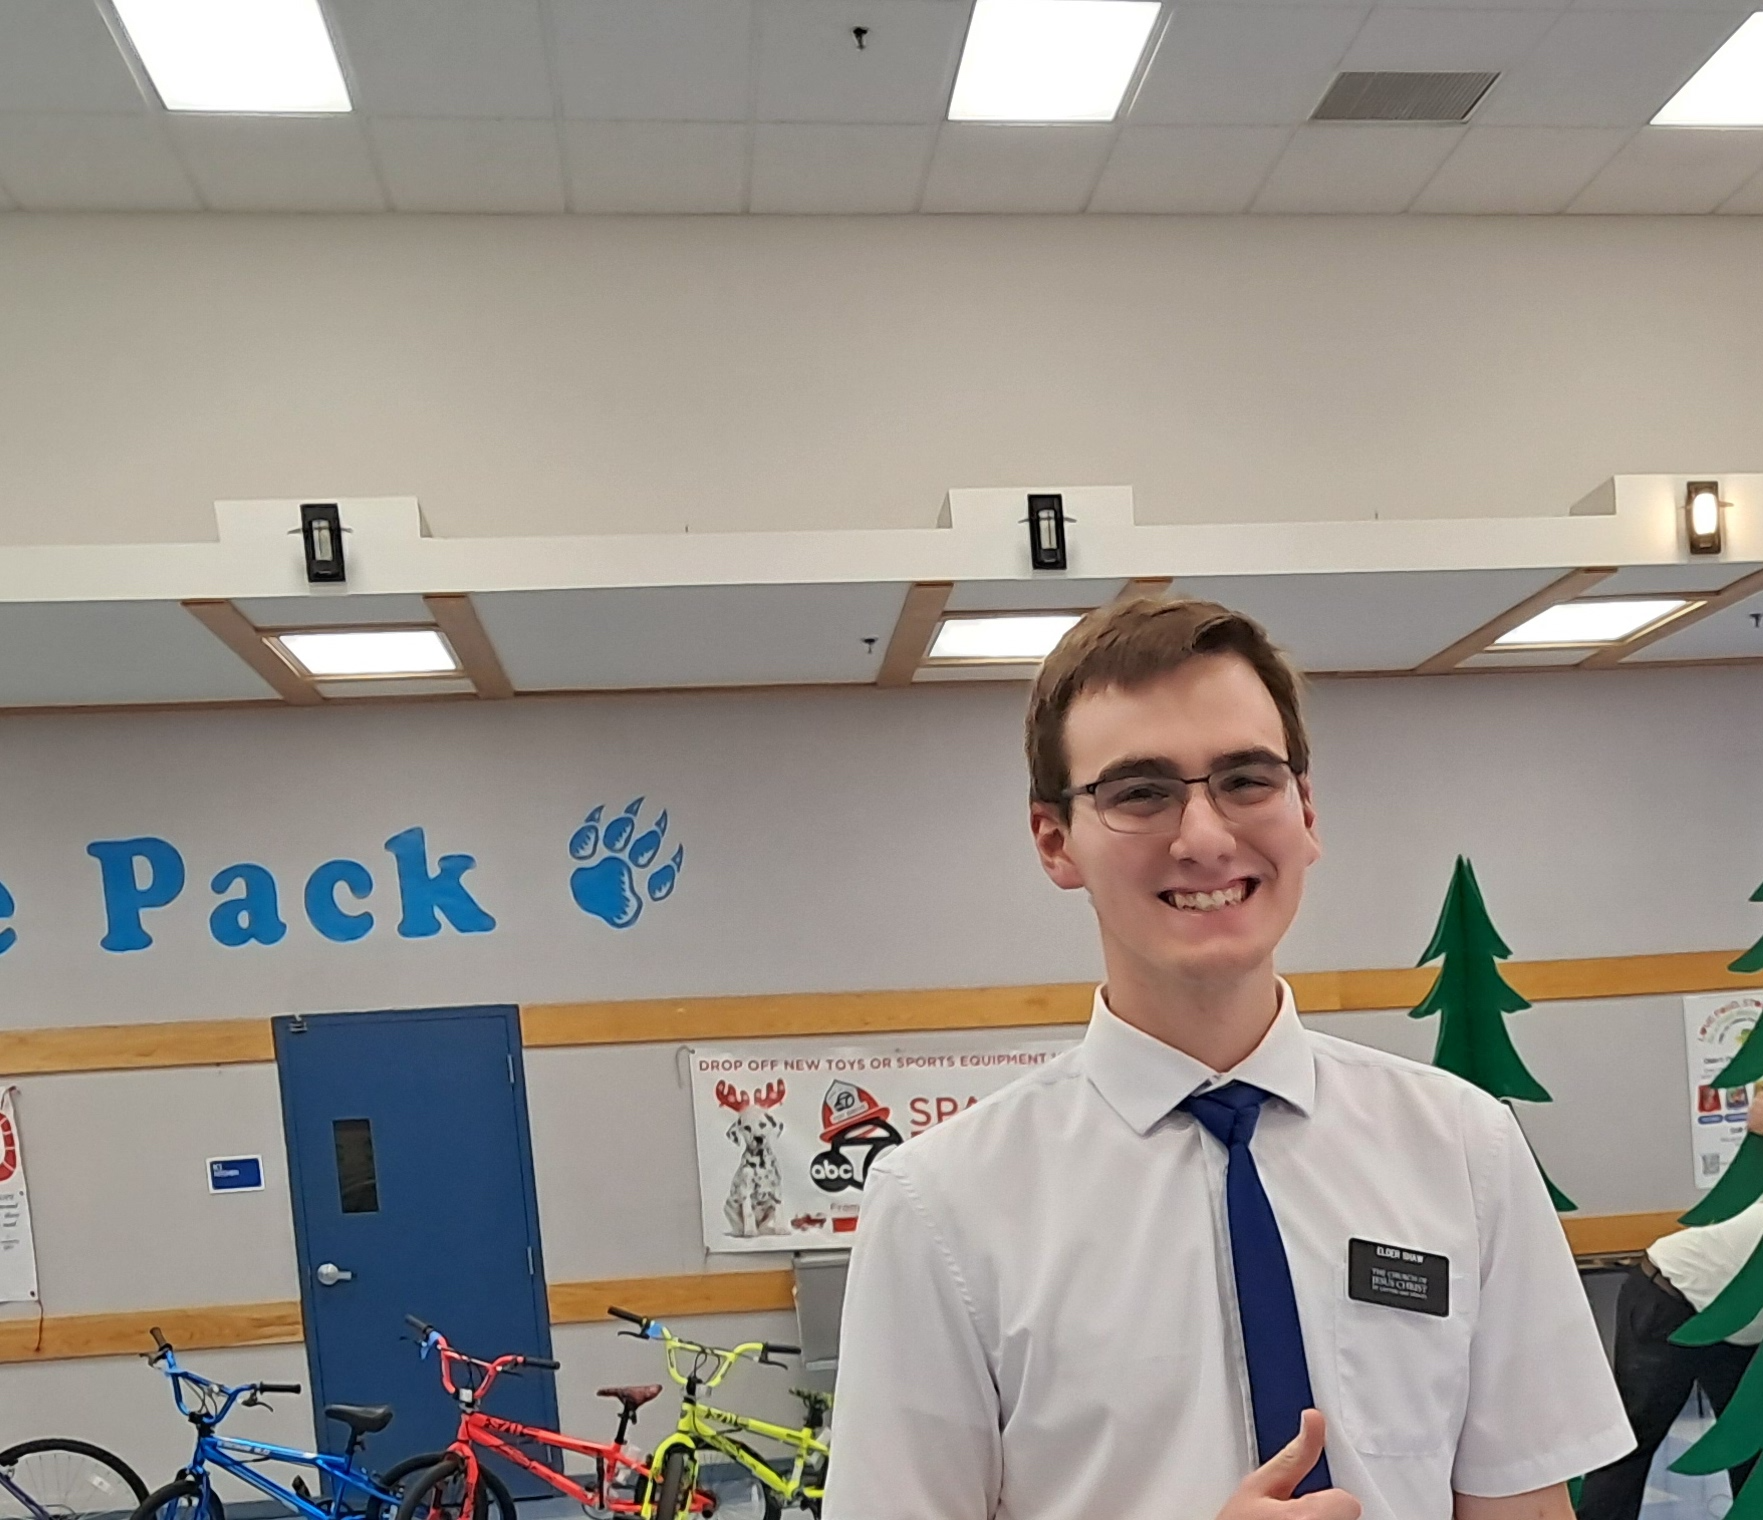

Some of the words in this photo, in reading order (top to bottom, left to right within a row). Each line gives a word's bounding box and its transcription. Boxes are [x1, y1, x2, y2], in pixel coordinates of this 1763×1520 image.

[86, 826, 497, 953] Pack
[699, 1059, 743, 1072] DROP
[747, 1059, 780, 1071] OFF
[783, 1059, 821, 1071] NEW
[826, 1058, 865, 1071] TOYS
[870, 1057, 892, 1069] OR
[897, 1055, 956, 1069] SPORTS
[960, 1053, 1046, 1067] EQUIPMENT
[811, 1159, 853, 1180] abc
